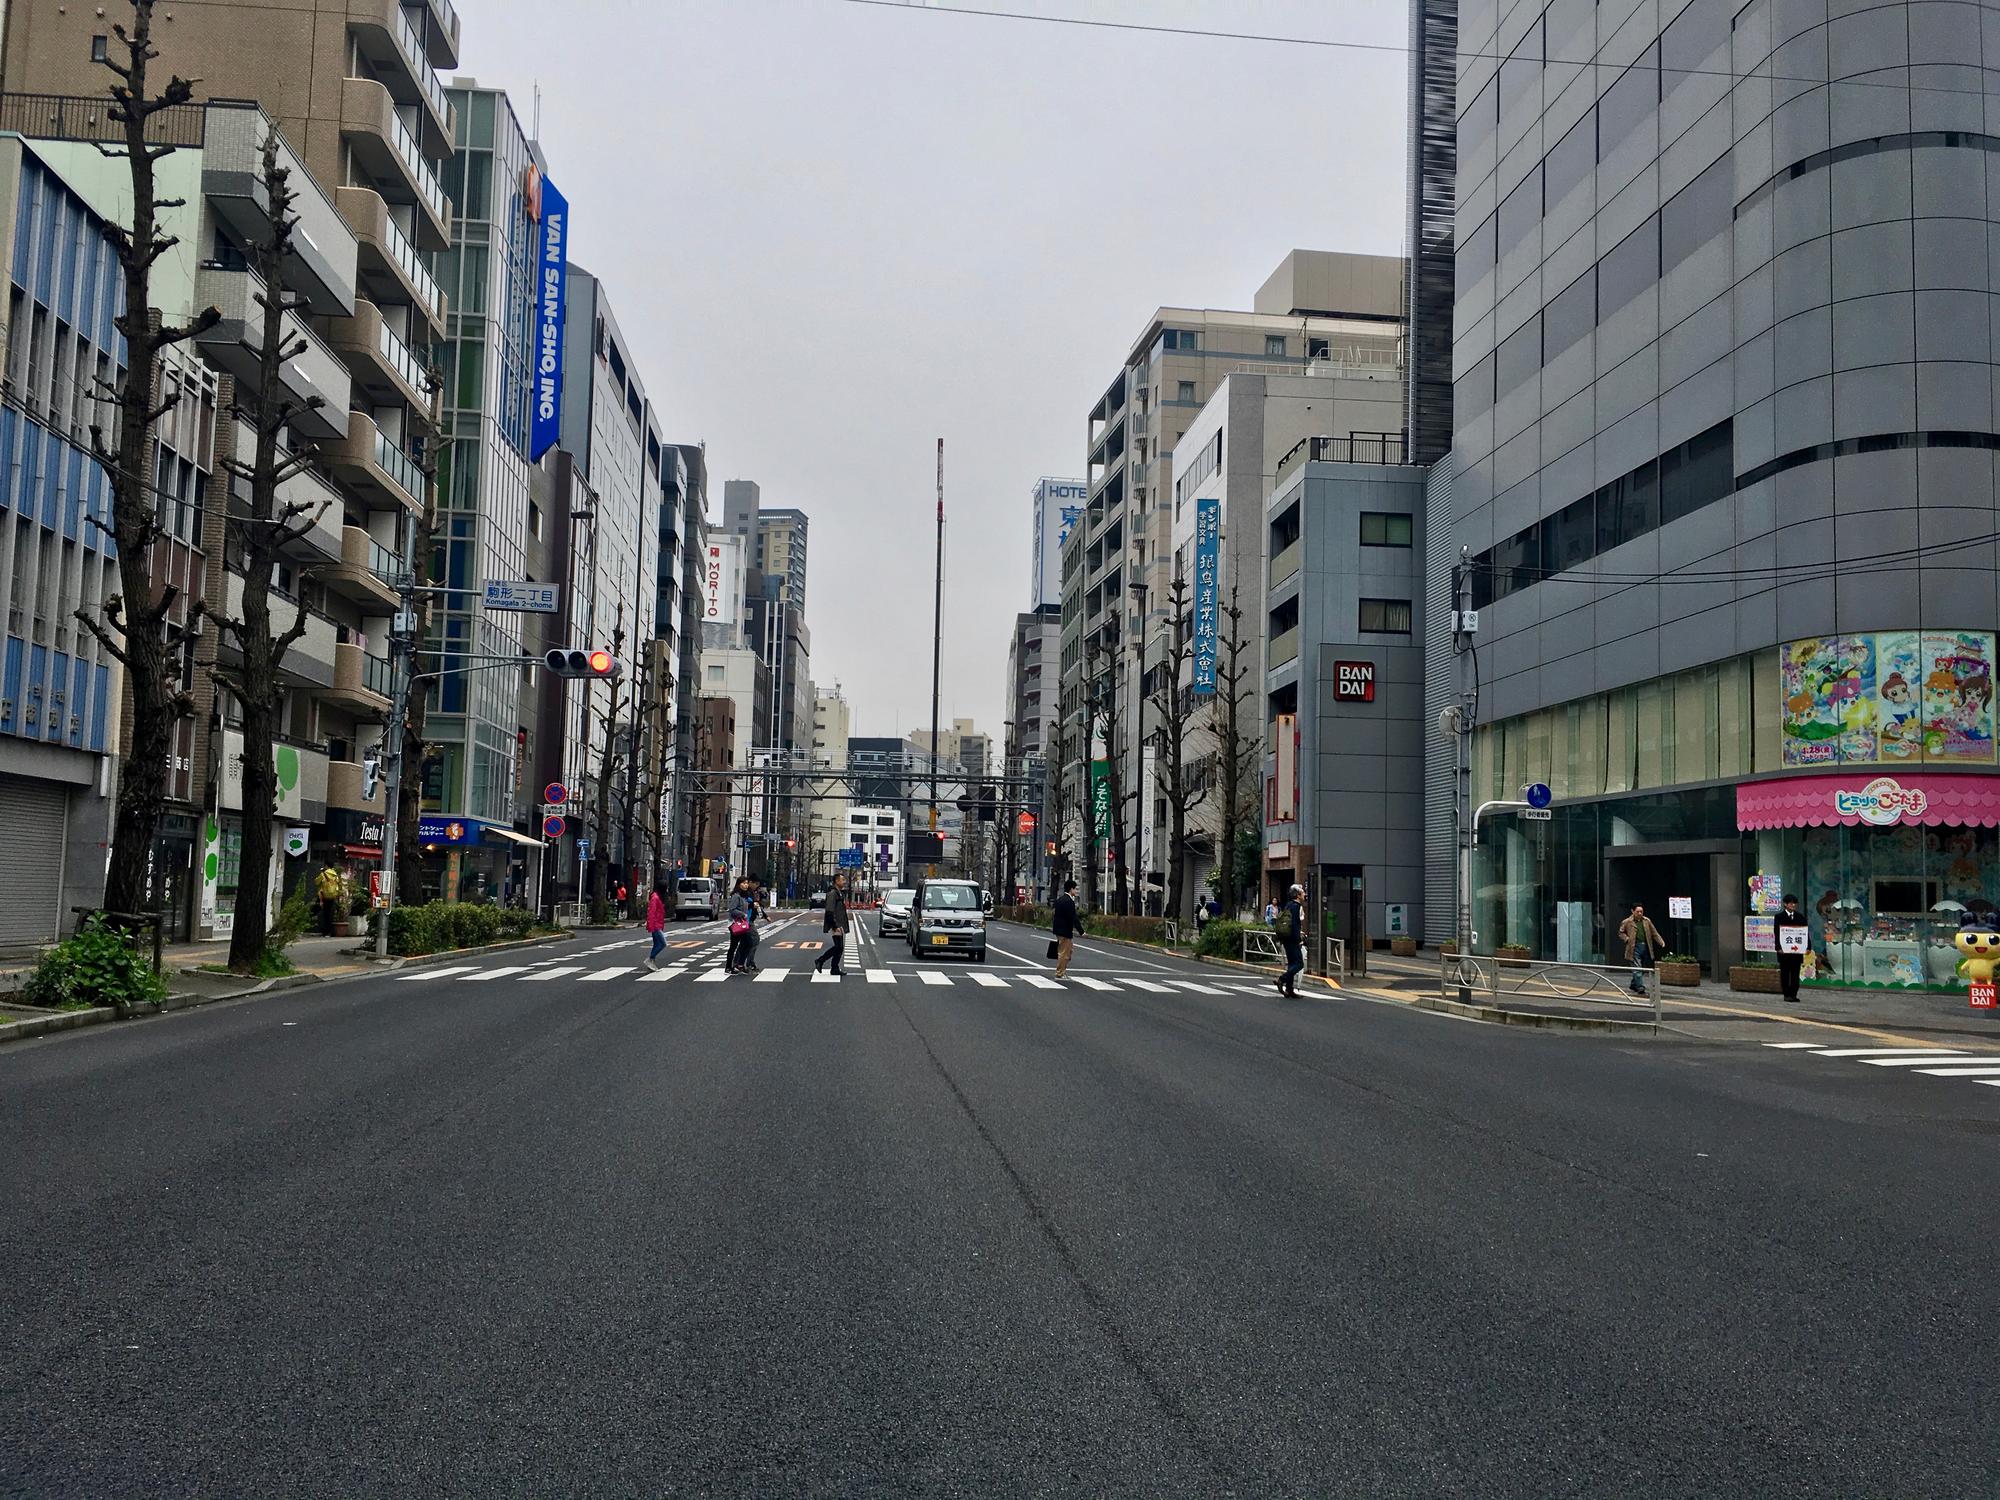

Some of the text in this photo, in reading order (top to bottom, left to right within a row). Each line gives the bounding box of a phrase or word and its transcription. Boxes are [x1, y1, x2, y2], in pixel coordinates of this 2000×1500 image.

[546, 214, 561, 262] VAN
[1050, 485, 1087, 499] HOTE
[487, 586, 553, 602] 駒形二丁目
[707, 562, 719, 616] MORITO
[485, 598, 553, 609] Komagata 2-chome
[1340, 666, 1372, 680] BAN
[1340, 681, 1365, 695] DAI
[1838, 792, 1923, 811] ヒミツのここたま
[771, 941, 823, 949] 50
[1971, 987, 1995, 997] BAN
[1971, 996, 1990, 1006] DAI
